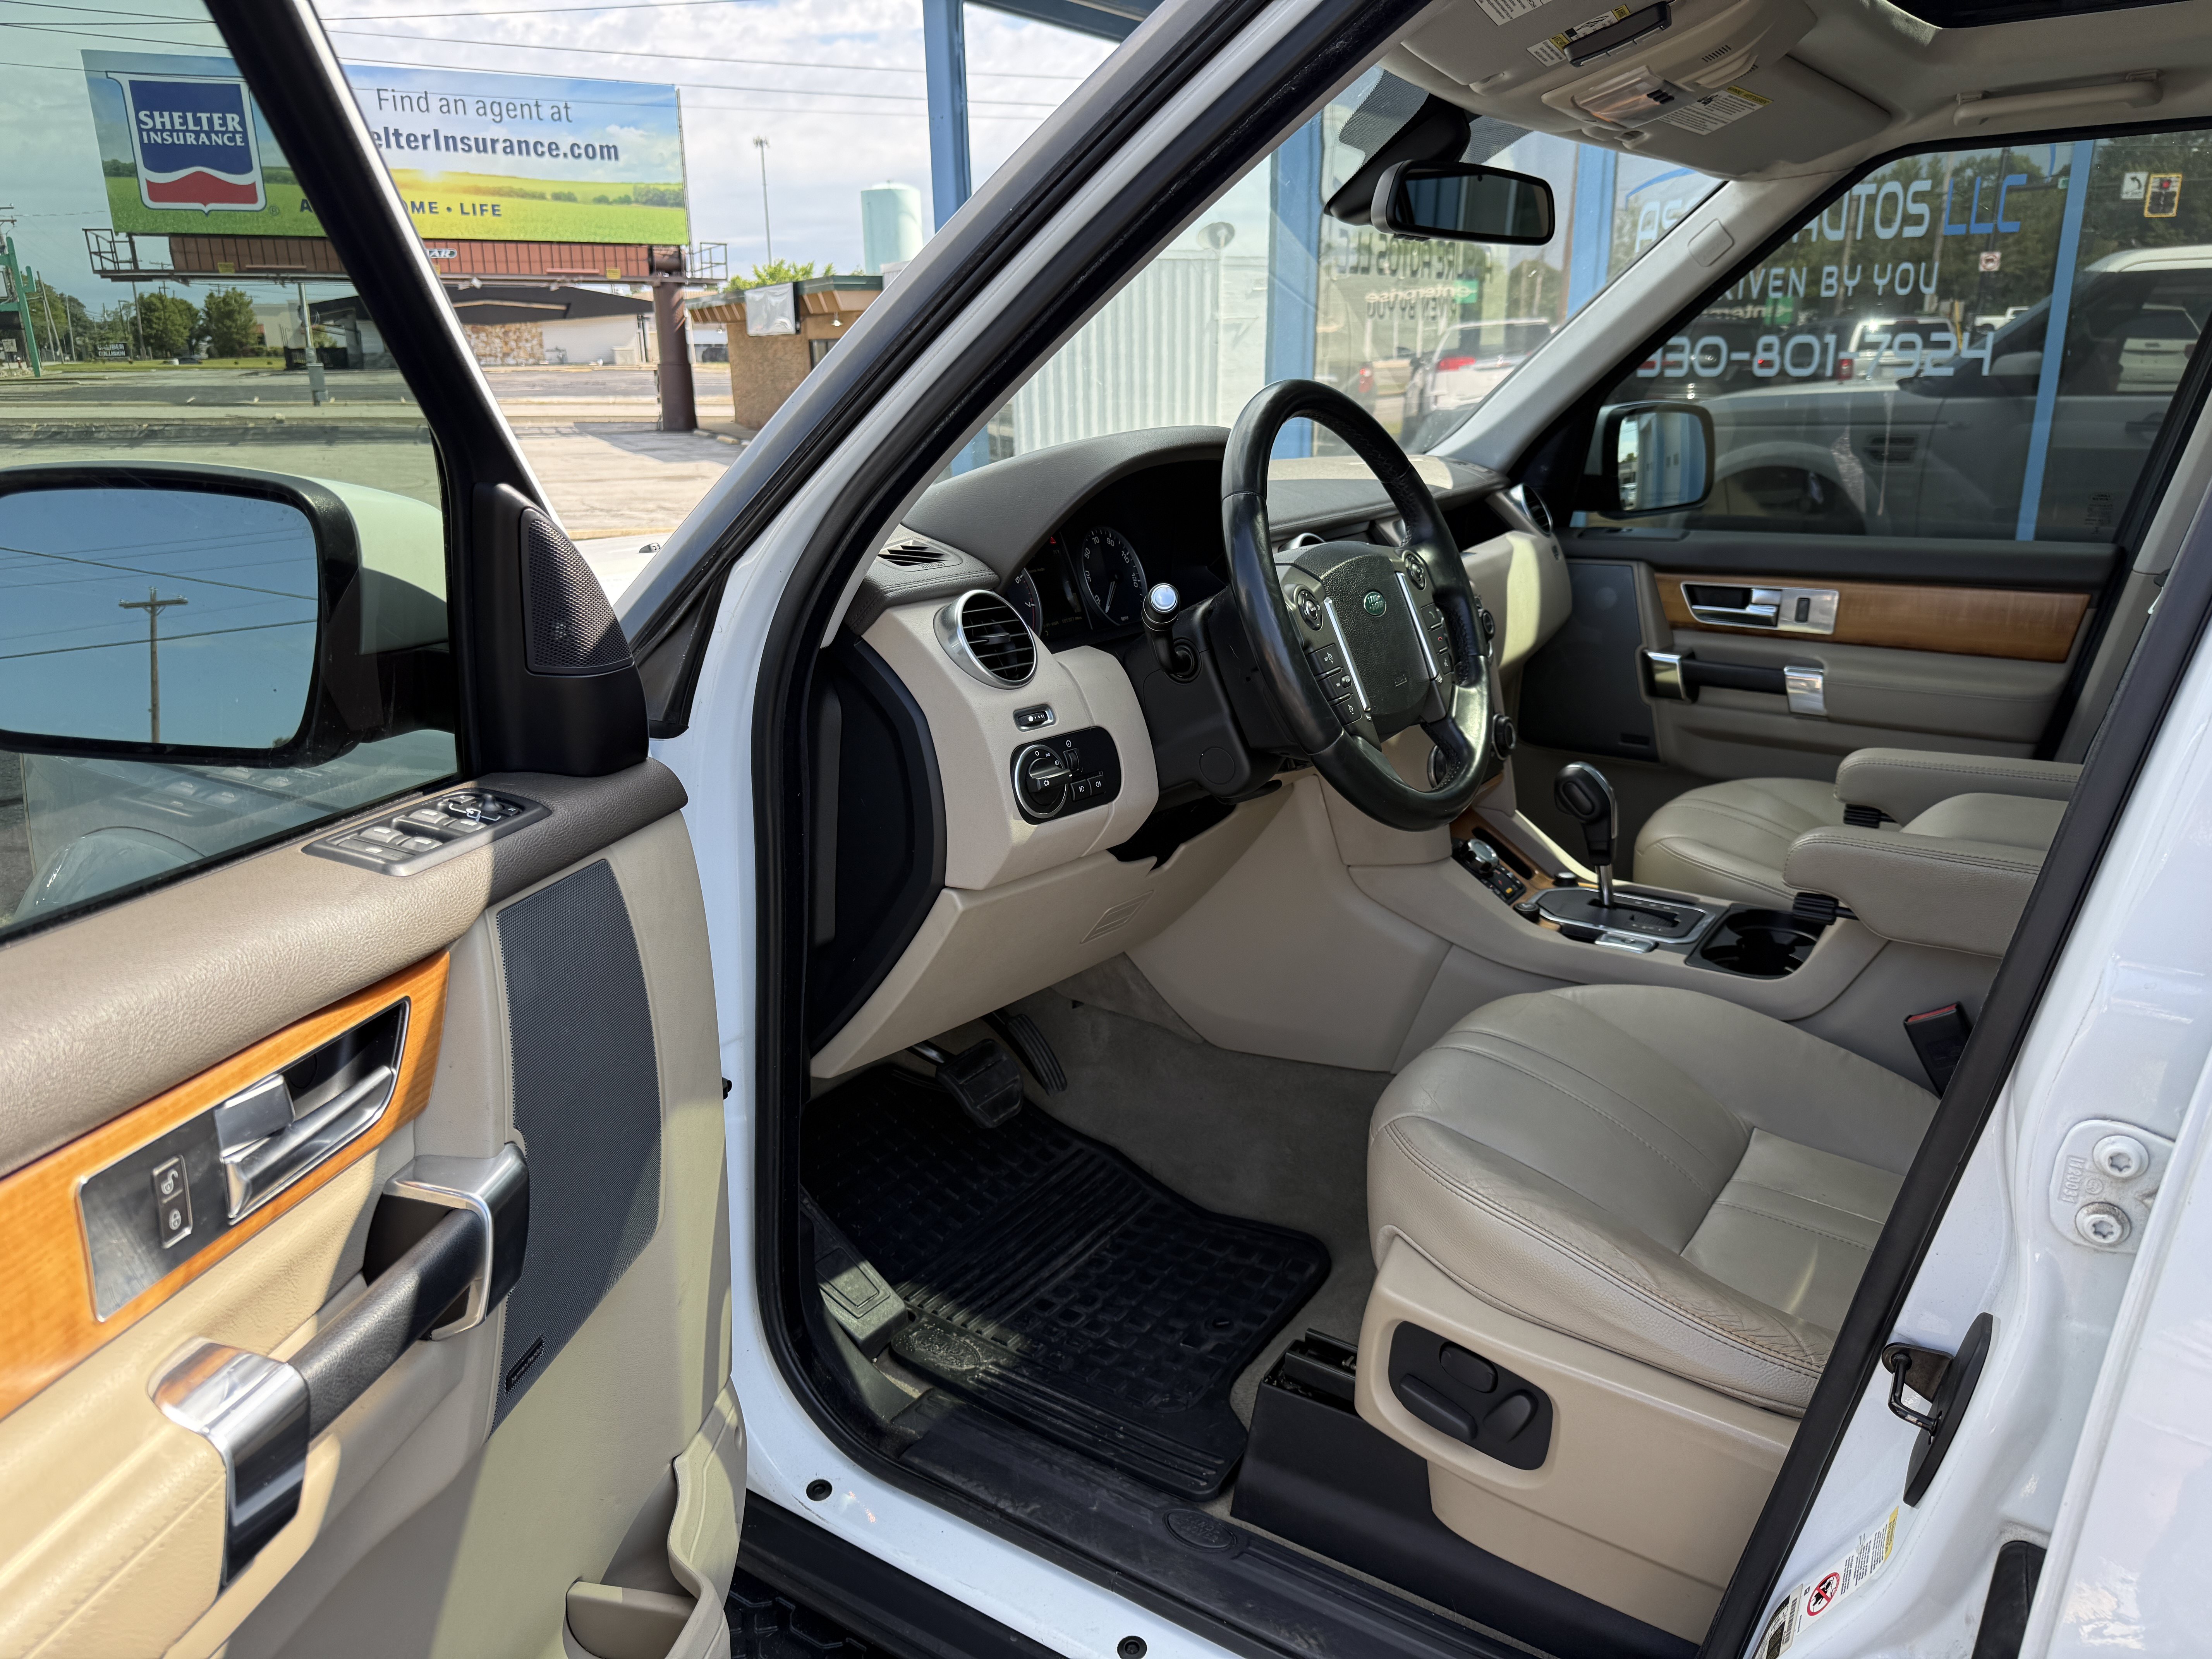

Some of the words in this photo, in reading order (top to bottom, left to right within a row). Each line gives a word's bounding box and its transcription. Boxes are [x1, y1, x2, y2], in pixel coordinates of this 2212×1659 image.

[377, 88, 429, 113] Find
[439, 96, 466, 115] an
[476, 99, 543, 123] agent
[551, 101, 573, 122] at
[138, 111, 243, 132] SHELTER
[142, 131, 245, 146] INSURANCE
[460, 203, 502, 216] LIFE
[1943, 174, 2027, 235] LLC
[1820, 263, 1862, 297] BY
[1873, 261, 1939, 296] YOU
[1092, 536, 1099, 544] 70
[1106, 537, 1115, 547] 90
[1084, 547, 1091, 559] 50
[1121, 550, 1130, 564] 110
